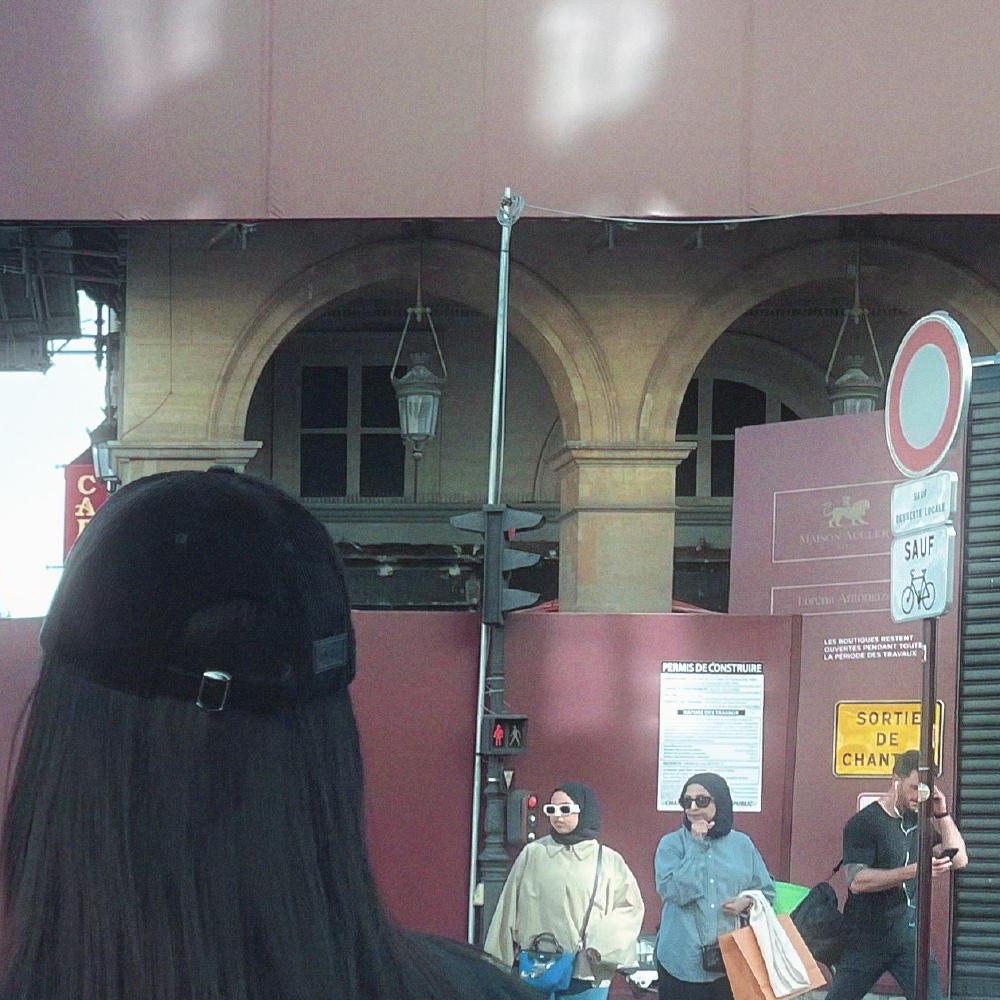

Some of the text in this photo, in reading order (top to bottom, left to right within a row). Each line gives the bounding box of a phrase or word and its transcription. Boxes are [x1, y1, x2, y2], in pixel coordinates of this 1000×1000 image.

[913, 488, 928, 501] SAUF
[924, 502, 946, 517] LOCALE
[799, 529, 890, 545] MAISON AUCLER
[904, 535, 935, 562] SAUF
[838, 636, 879, 645] BOUTIQUES
[880, 634, 914, 642] RESTENT
[823, 641, 923, 653] OUVERTES PENDANT TOUTE
[883, 650, 917, 658] TRAVAUX
[662, 662, 763, 673] PERMIS DE CONSTRUIRE
[856, 711, 922, 726] SORTIE
[876, 732, 899, 746] DE
[842, 752, 896, 767] CHAN
